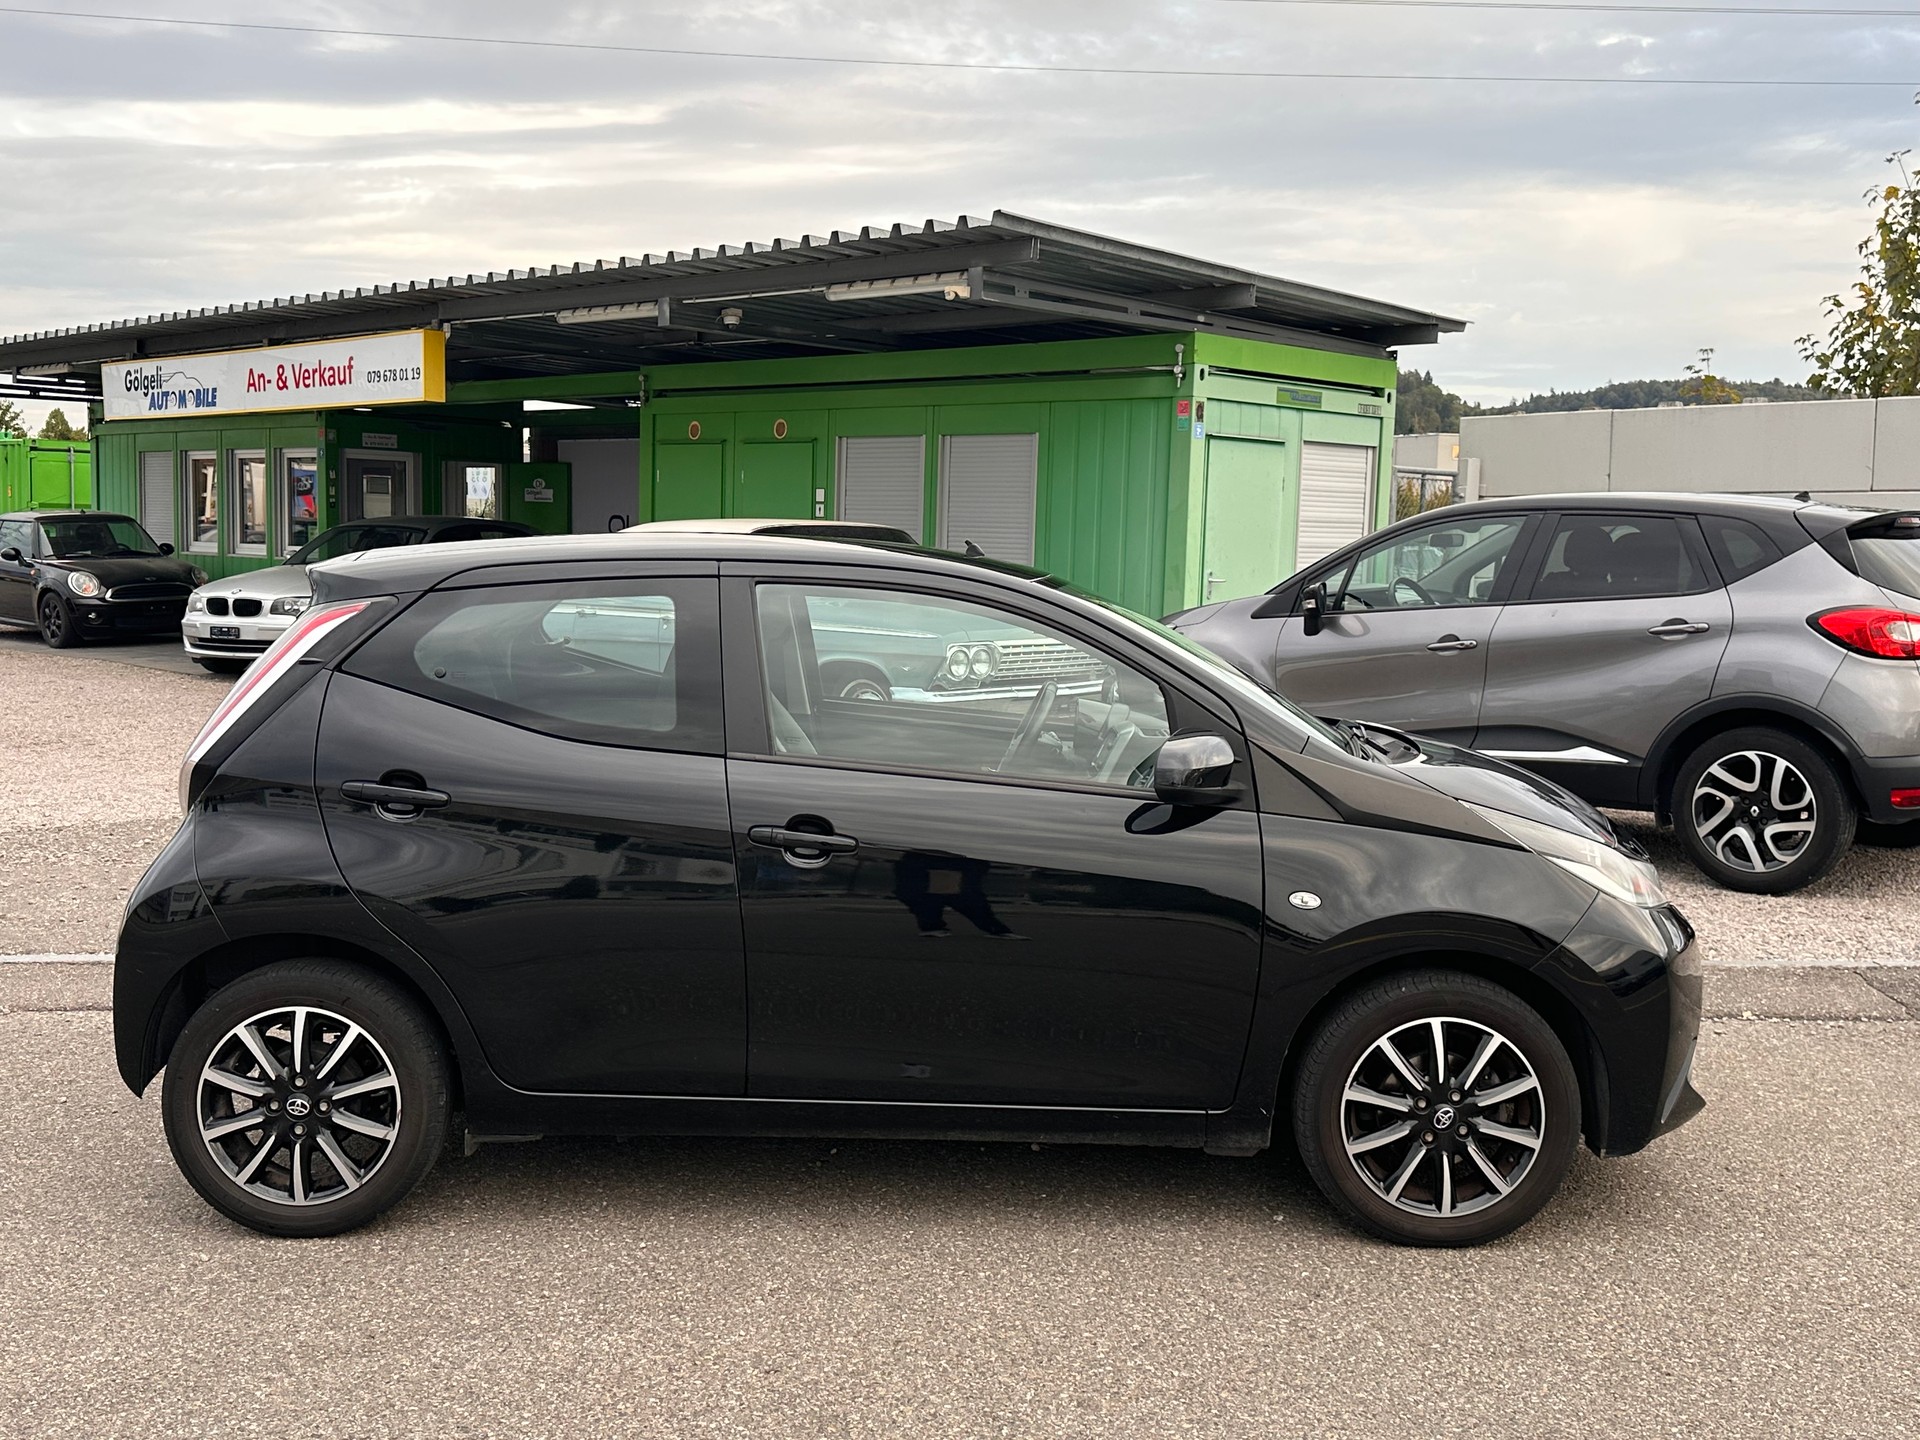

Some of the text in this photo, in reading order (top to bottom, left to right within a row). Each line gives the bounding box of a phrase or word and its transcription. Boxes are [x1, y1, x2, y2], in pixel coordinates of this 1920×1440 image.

[125, 366, 162, 397] Gölgeli
[247, 368, 272, 393] An-
[276, 364, 289, 391] &
[291, 356, 354, 389] Verkauf
[367, 367, 421, 383] 079 678 01 19
